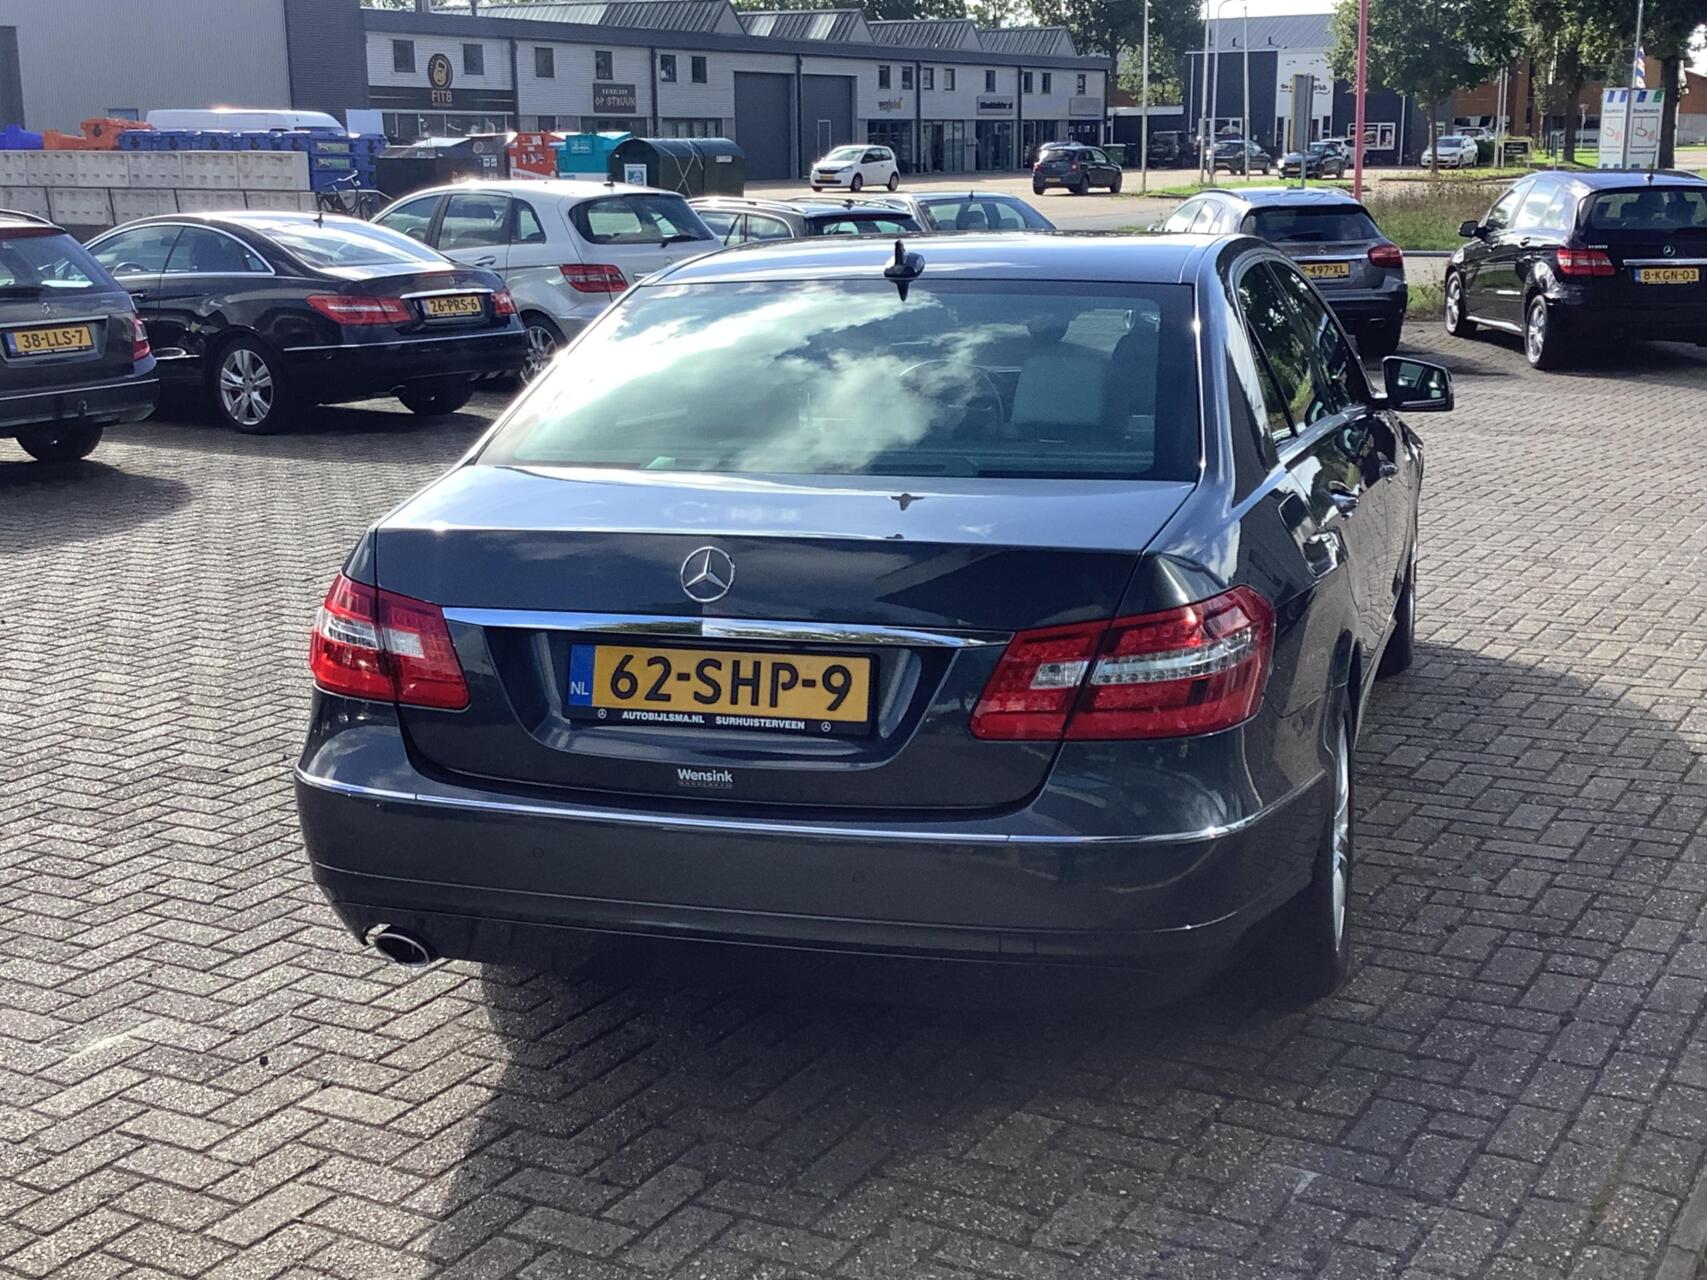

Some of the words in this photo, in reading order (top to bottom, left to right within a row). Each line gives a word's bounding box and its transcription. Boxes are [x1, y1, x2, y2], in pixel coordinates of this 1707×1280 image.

[1642, 270, 1697, 281] 8-KGN-03
[430, 297, 478, 313] 26-PRS-6
[21, 329, 83, 349] 38-LLS-7
[570, 680, 589, 696] NL
[610, 654, 853, 711] 62-SHP-9
[622, 710, 705, 725] AUTOBIJLSMA.NL
[715, 715, 805, 730] SURHUISTERVEEN
[677, 768, 733, 783] Wensink
